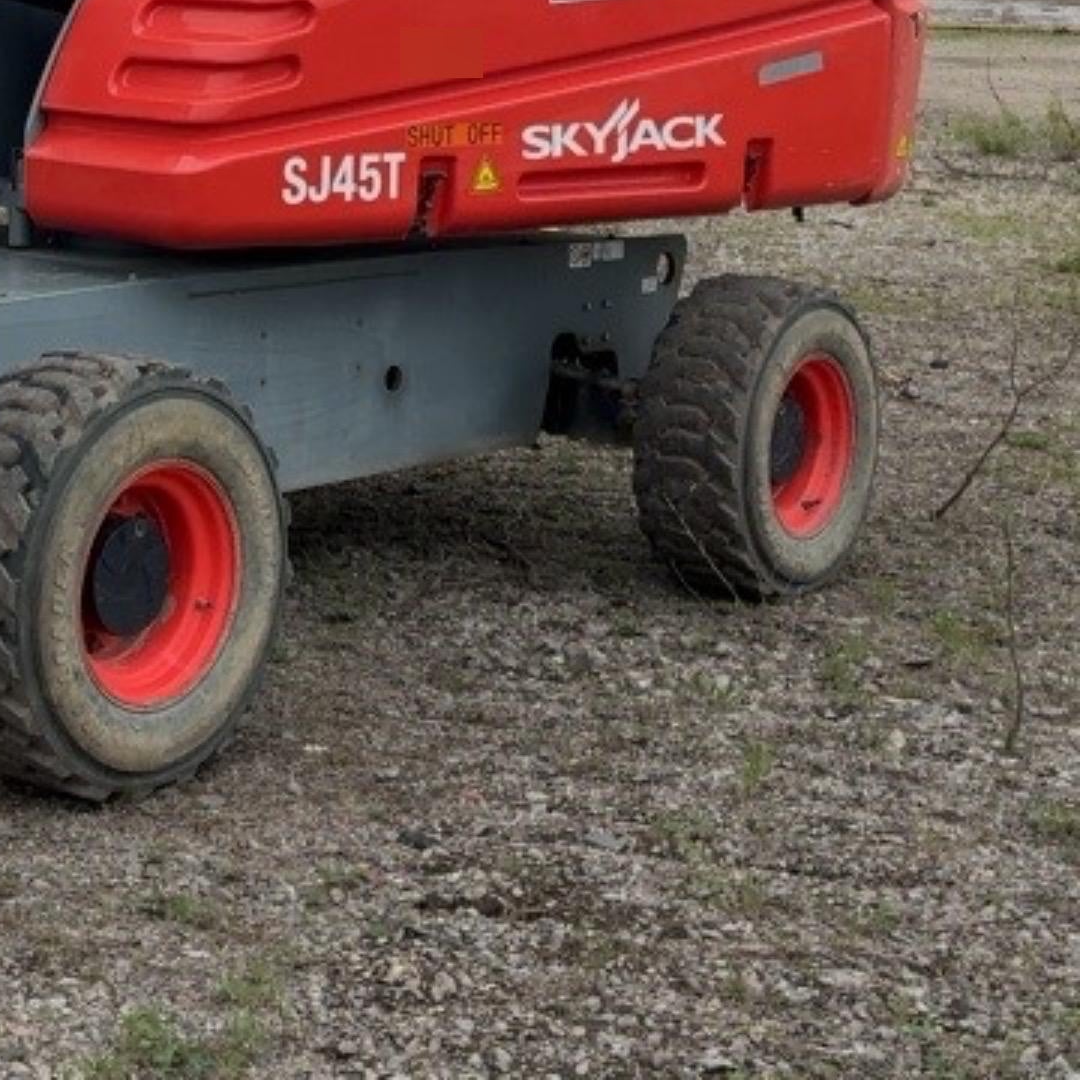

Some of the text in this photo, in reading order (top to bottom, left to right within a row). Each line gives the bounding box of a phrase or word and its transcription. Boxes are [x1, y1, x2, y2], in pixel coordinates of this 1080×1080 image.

[407, 122, 503, 148] SHUT OFF
[521, 98, 726, 163] SKYJACK
[281, 152, 406, 205] SJ45T
